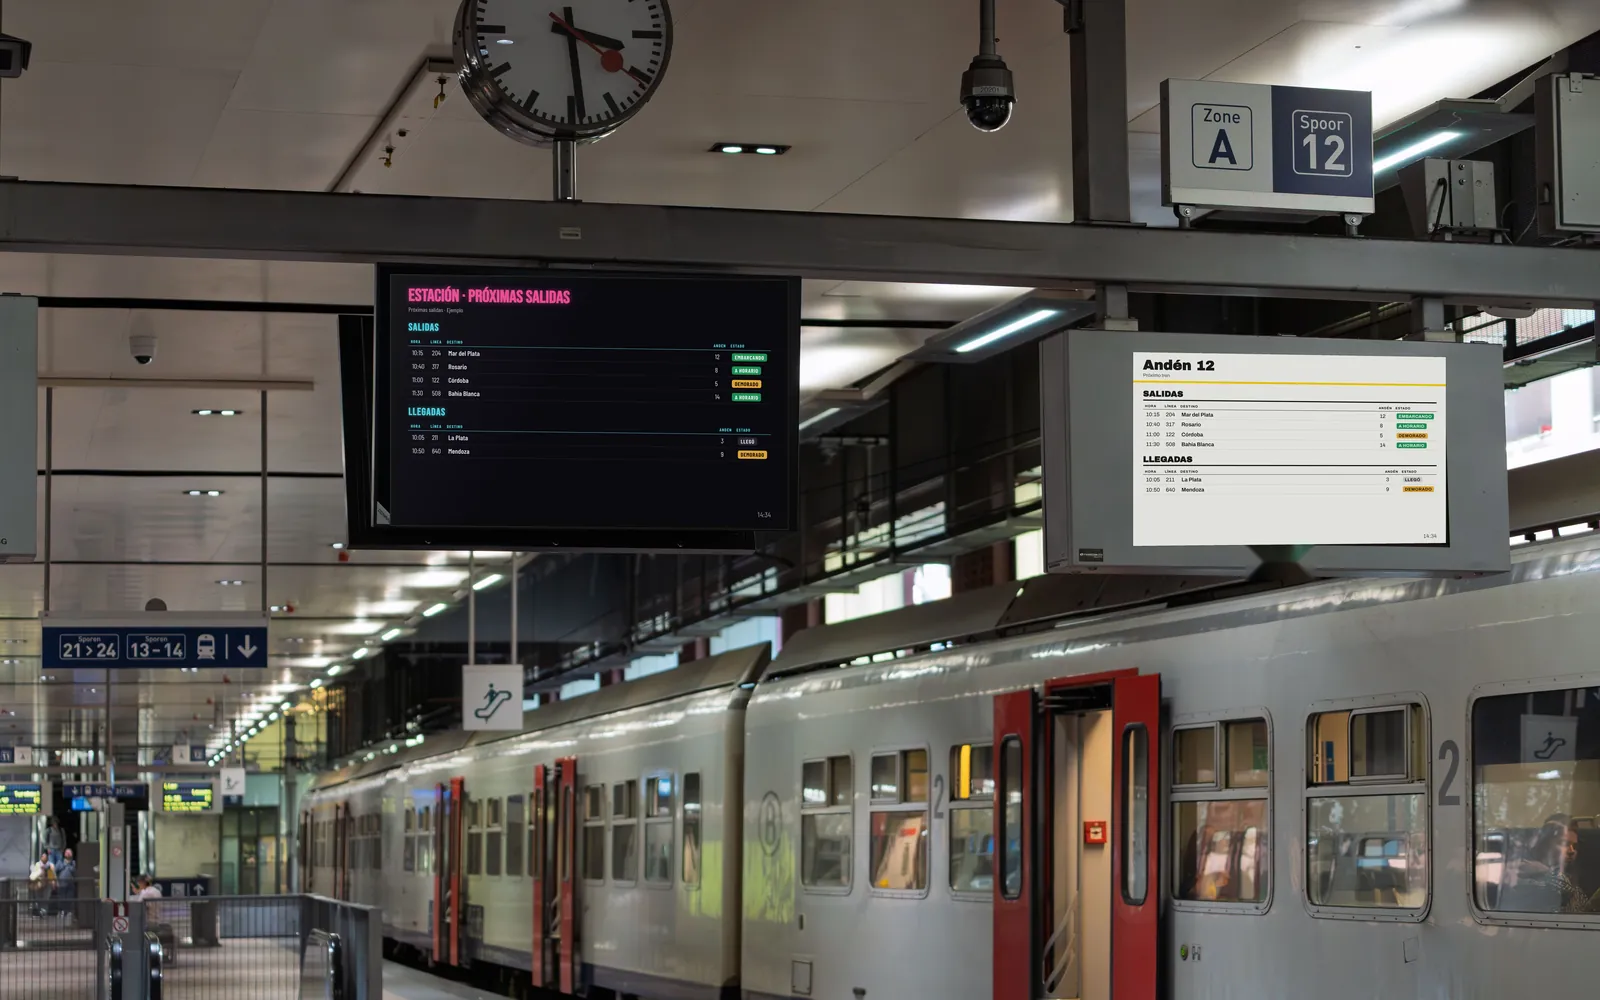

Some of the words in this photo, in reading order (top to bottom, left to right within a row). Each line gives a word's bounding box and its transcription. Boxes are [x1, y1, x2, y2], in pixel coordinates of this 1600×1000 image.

[1204, 108, 1240, 123] Zone
[1300, 115, 1343, 132] Spoor
[1208, 129, 1237, 164] A
[1303, 134, 1345, 171] 12
[408, 286, 459, 302] ESTACIÓN
[468, 287, 523, 303] PRÓXIMAS
[526, 290, 570, 304] SALIDAS
[408, 323, 439, 331] SALIDAS
[1143, 359, 1192, 370] Andén
[1197, 361, 1215, 371] 12
[408, 407, 446, 416] LLEGADAS
[1438, 739, 1460, 806] 2
[934, 774, 944, 819] 2
